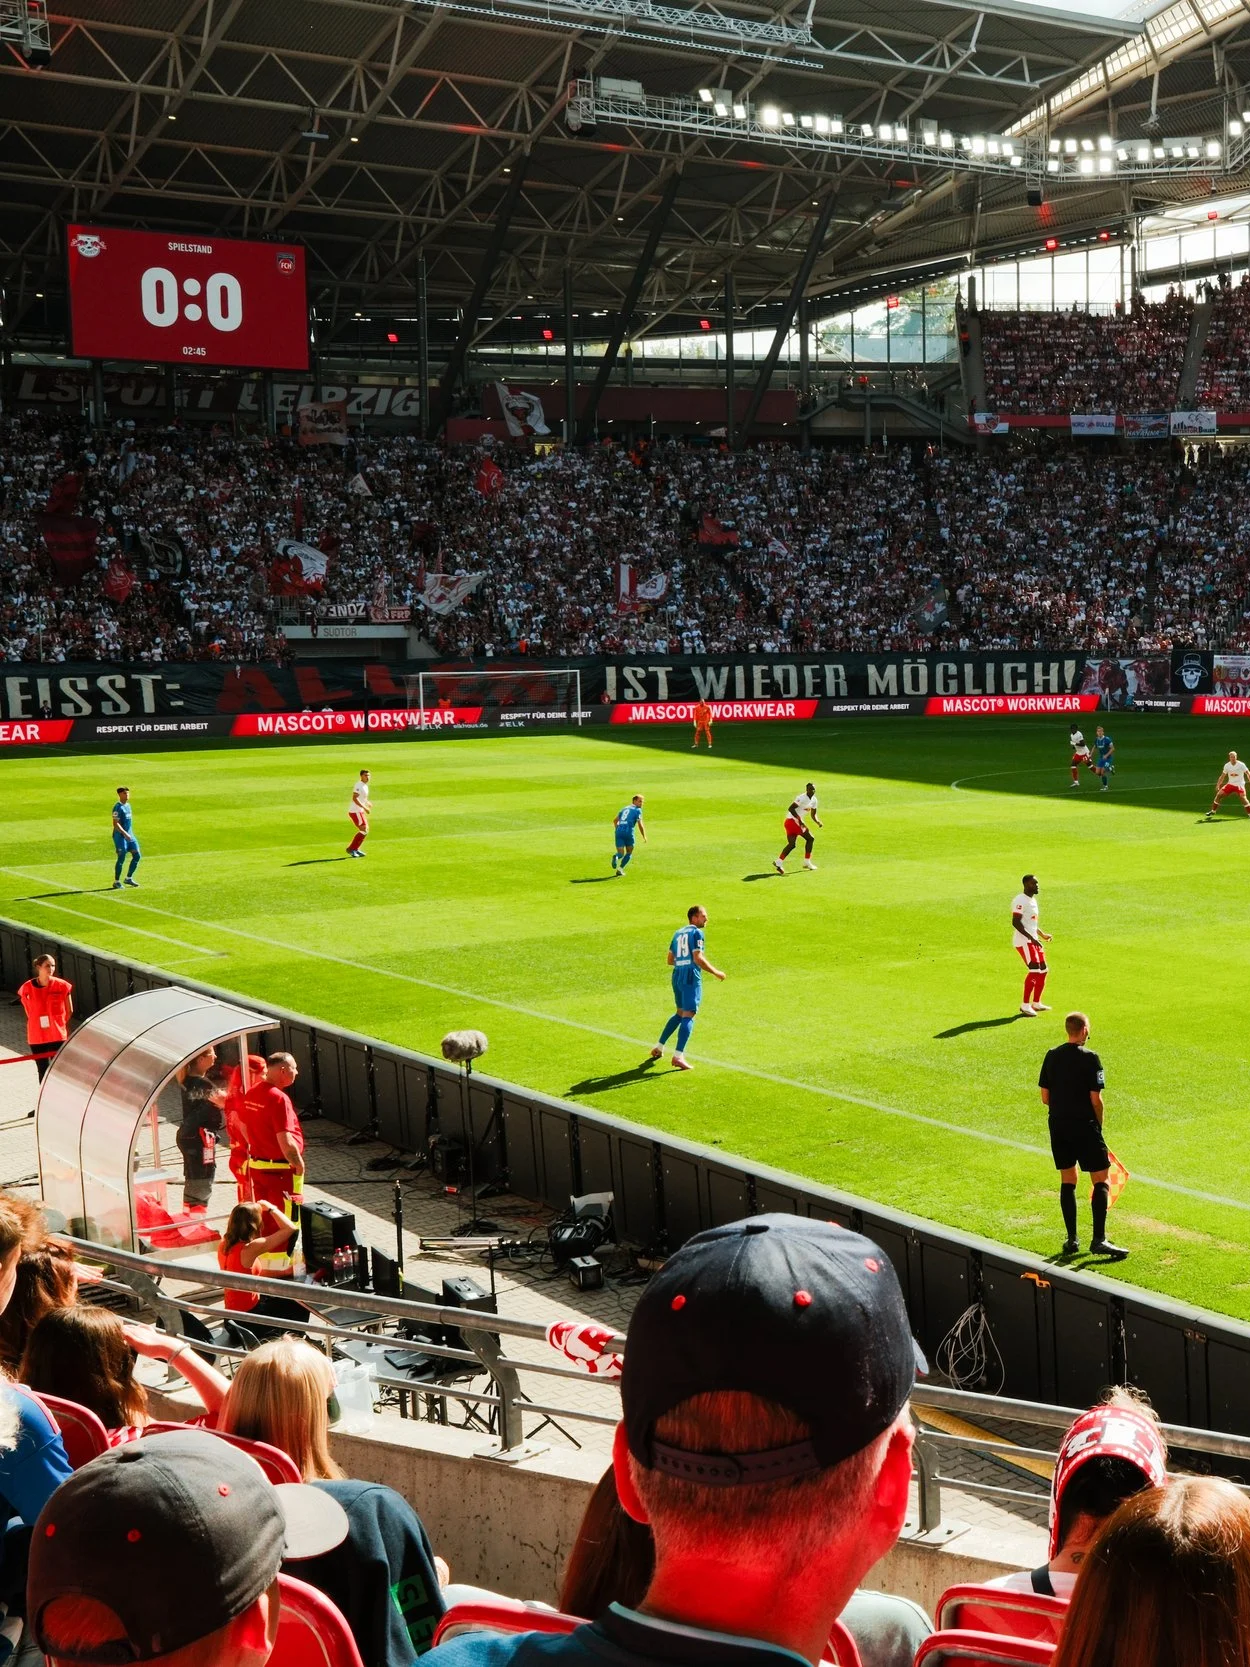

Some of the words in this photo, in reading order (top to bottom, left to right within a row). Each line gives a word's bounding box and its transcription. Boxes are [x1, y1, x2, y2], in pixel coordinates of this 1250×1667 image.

[168, 242, 212, 254] SPIELSTAND
[141, 267, 242, 332] 0:0
[182, 346, 206, 356] 02:45
[238, 382, 420, 416] LEIPZIG
[606, 666, 673, 700] IST
[694, 664, 848, 700] WIEDER
[868, 659, 1076, 698] MÖGLICH!
[710, 704, 795, 718] WORKWEAR
[1007, 698, 1080, 711] WORKWEAR
[136, 724, 152, 732] FÜR
[350, 711, 455, 729] WORKWEAR
[676, 934, 689, 958] 19
